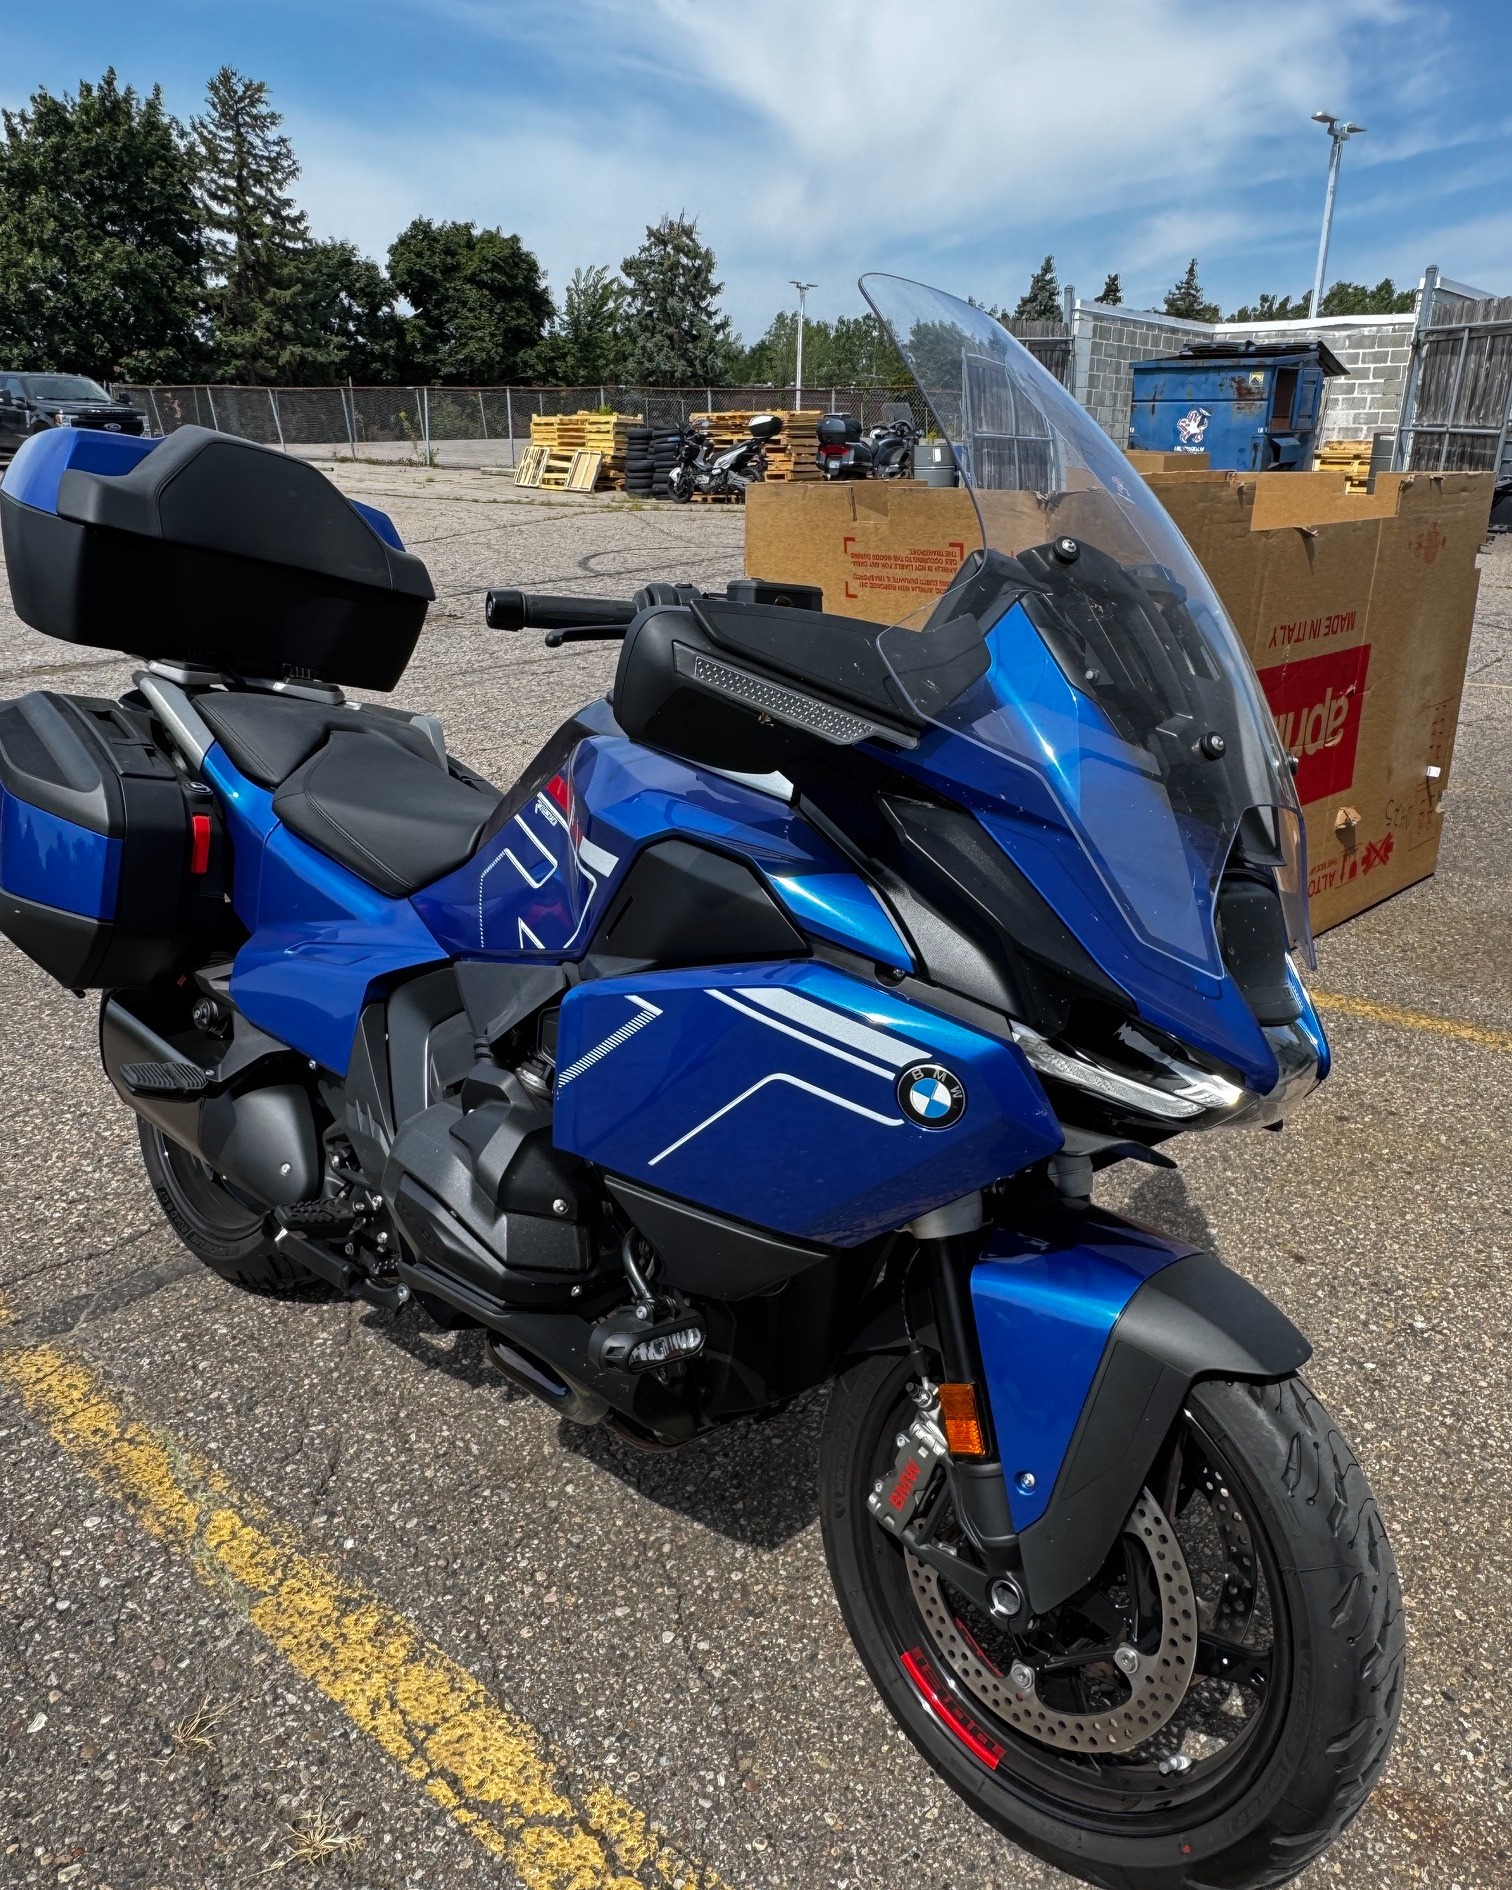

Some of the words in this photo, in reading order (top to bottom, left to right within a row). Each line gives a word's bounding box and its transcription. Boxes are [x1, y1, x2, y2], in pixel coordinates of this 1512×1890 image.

[1268, 621, 1307, 649] ITALY
[1309, 618, 1322, 640] IN
[1323, 611, 1356, 637] MADE
[1308, 870, 1336, 898] ALTO
[888, 1457, 920, 1512] BMW
